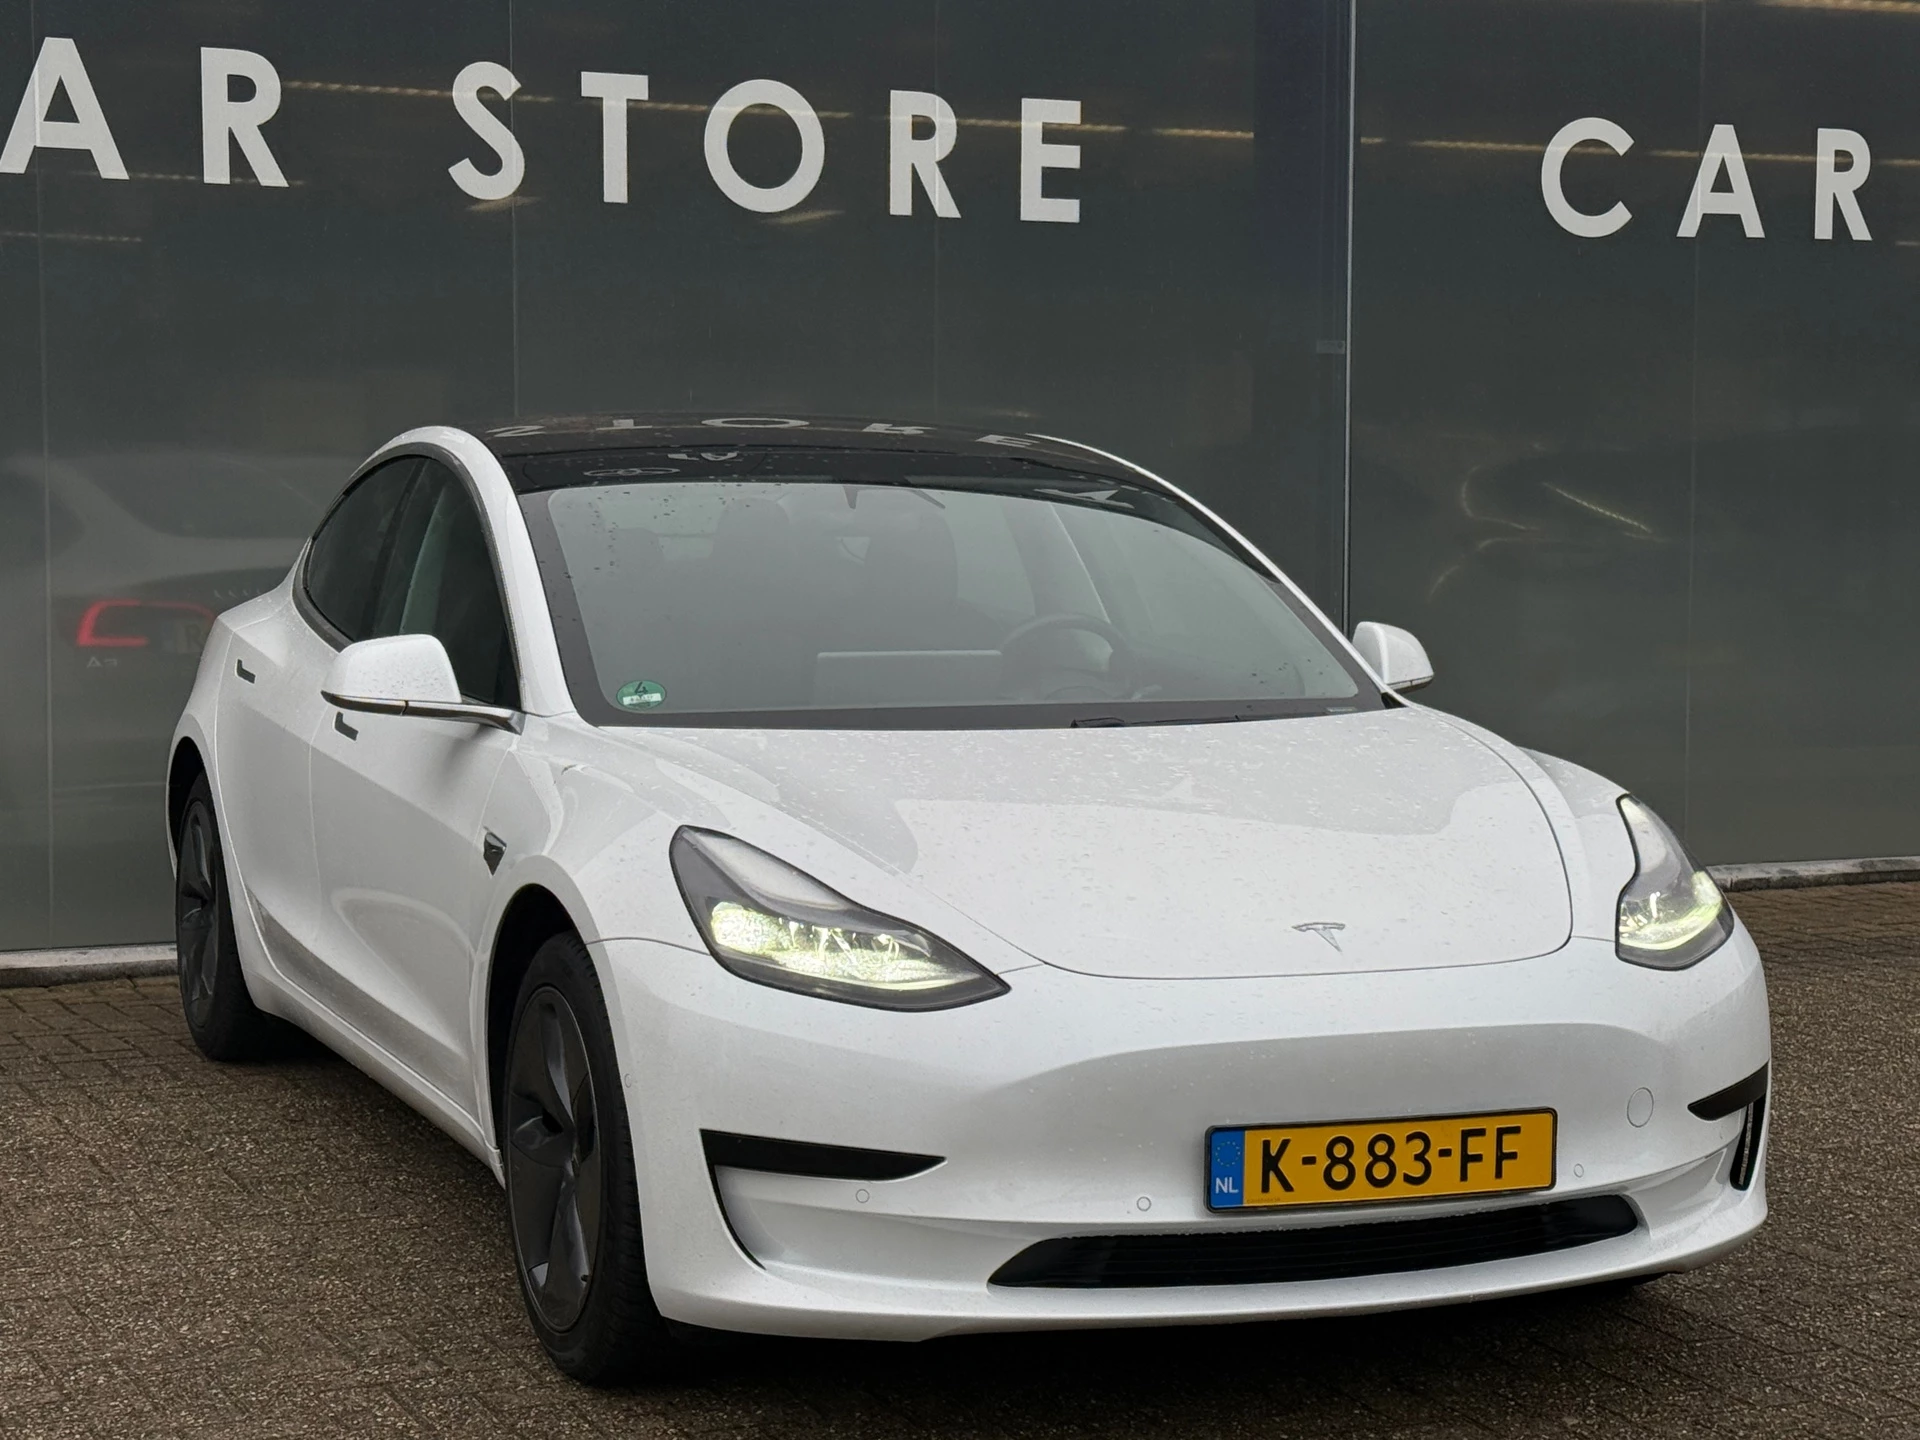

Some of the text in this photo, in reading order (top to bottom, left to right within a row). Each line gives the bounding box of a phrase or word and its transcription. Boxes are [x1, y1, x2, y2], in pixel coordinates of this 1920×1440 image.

[0, 37, 1083, 222] AR STORE
[1541, 117, 1873, 240] CAR
[1214, 1177, 1239, 1194] NL
[1260, 1125, 1522, 1193] K-883-FF
